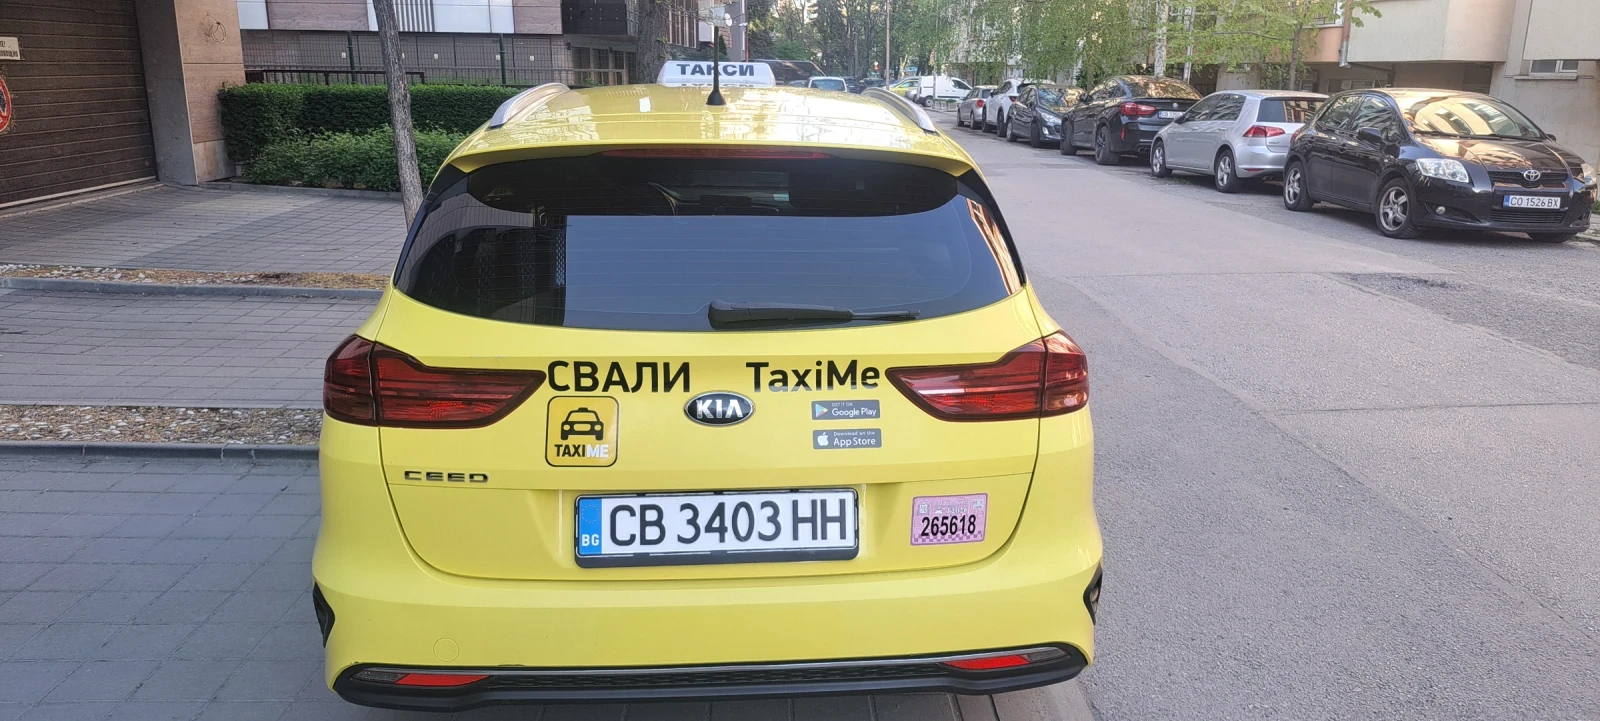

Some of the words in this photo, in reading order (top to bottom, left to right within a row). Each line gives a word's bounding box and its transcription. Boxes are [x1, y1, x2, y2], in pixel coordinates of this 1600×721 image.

[676, 64, 754, 76] ТАКСИ
[1510, 196, 1524, 206] CO
[1526, 197, 1546, 207] 1526
[1547, 198, 1559, 208] BX
[548, 360, 690, 393] СВАЛИ
[746, 360, 880, 392] TaxiMe
[695, 399, 744, 419] KIA
[832, 408, 860, 417] Google
[861, 408, 877, 417] Play
[834, 438, 852, 447] App
[853, 437, 876, 446] Store
[404, 470, 488, 483] CEED
[610, 504, 666, 546] CB
[677, 500, 782, 544] 3403
[792, 498, 846, 541] HH
[920, 514, 976, 536] 265618
[582, 534, 600, 547] BG
